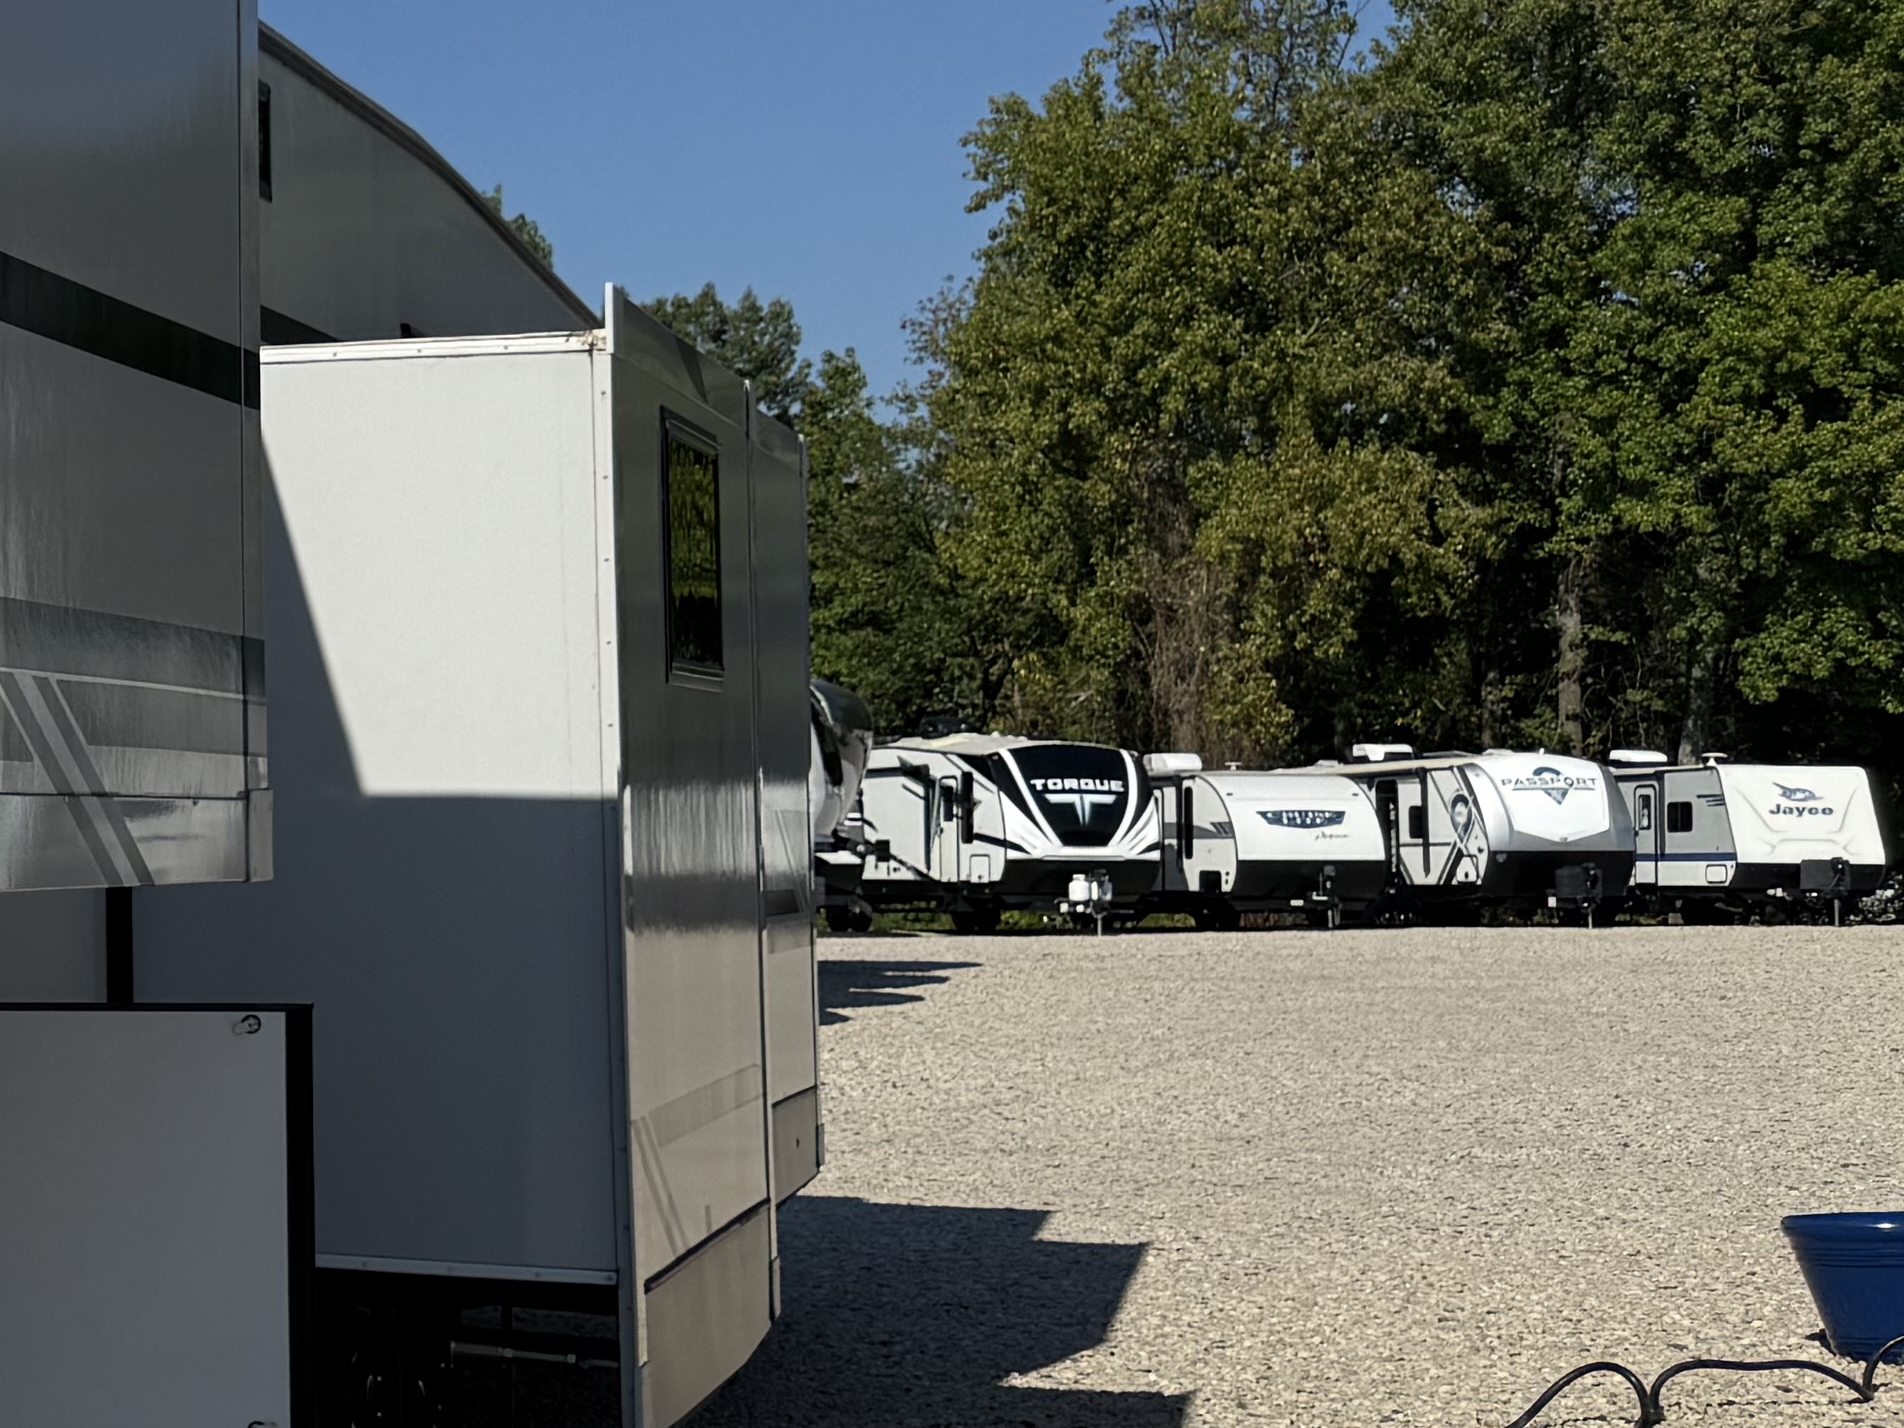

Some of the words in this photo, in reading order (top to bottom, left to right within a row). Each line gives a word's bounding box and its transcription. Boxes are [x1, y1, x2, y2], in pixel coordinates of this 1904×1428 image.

[1030, 777, 1125, 792] TORQUE
[1500, 776, 1598, 788] PASSPORT
[1769, 803, 1834, 818] Jayco
